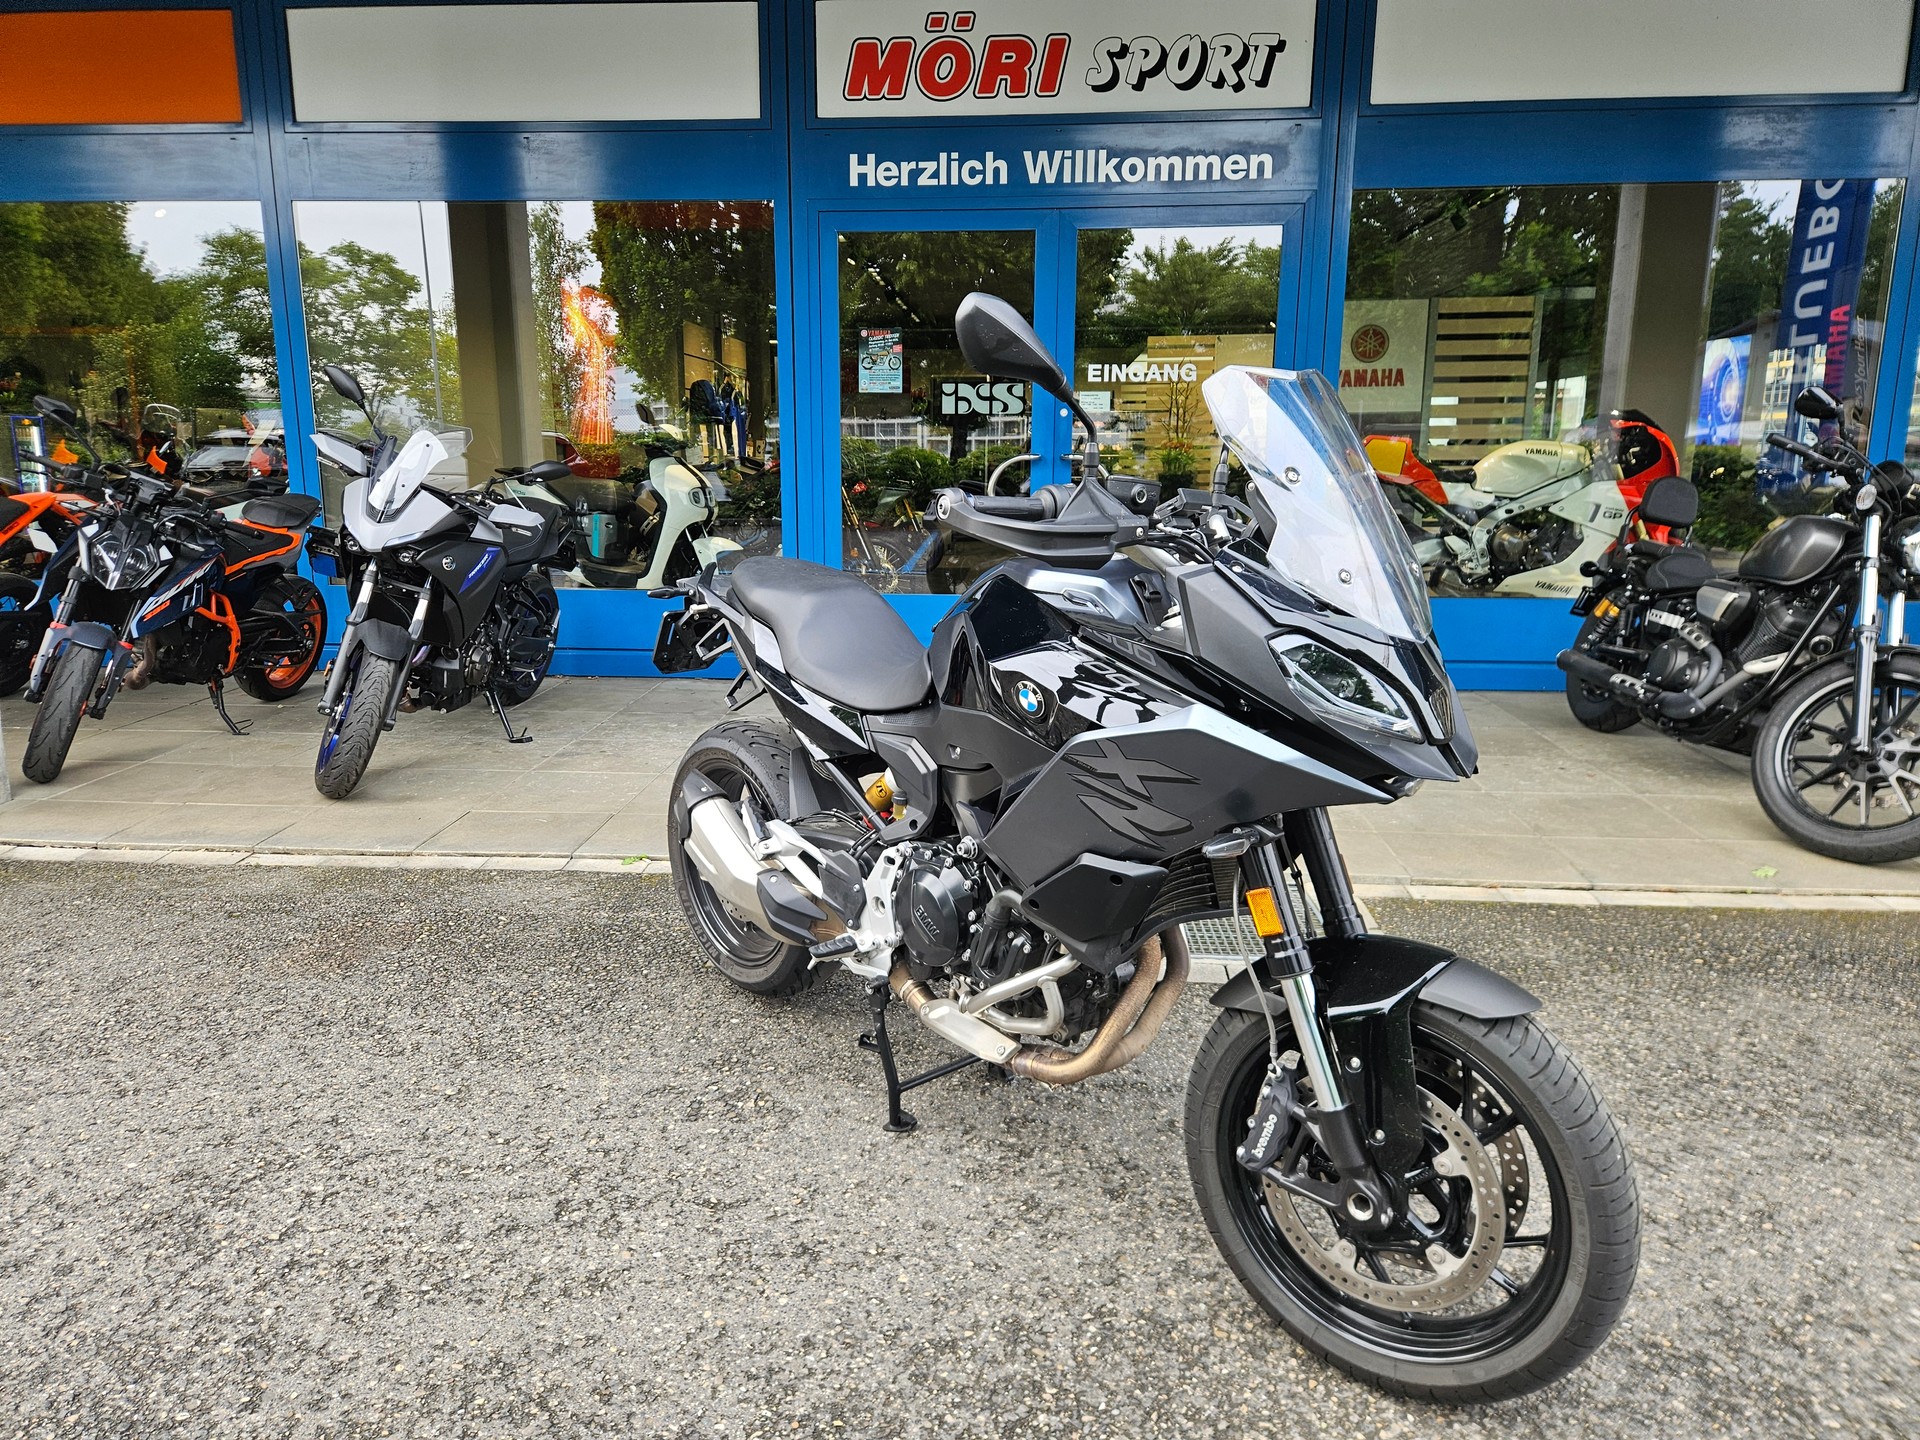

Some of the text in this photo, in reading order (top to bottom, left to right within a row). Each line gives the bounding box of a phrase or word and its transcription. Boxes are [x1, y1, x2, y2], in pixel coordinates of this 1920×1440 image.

[843, 11, 1287, 102] MÖRI SPORT
[849, 149, 1273, 187] Herzlich Willkommen
[1823, 303, 1851, 398] AMAHA
[1087, 363, 1198, 383] EINGANG
[1524, 447, 1559, 457] YAMAHA
[1602, 510, 1623, 520] GP
[915, 904, 940, 936] BMW
[1251, 1113, 1278, 1159] brembo
